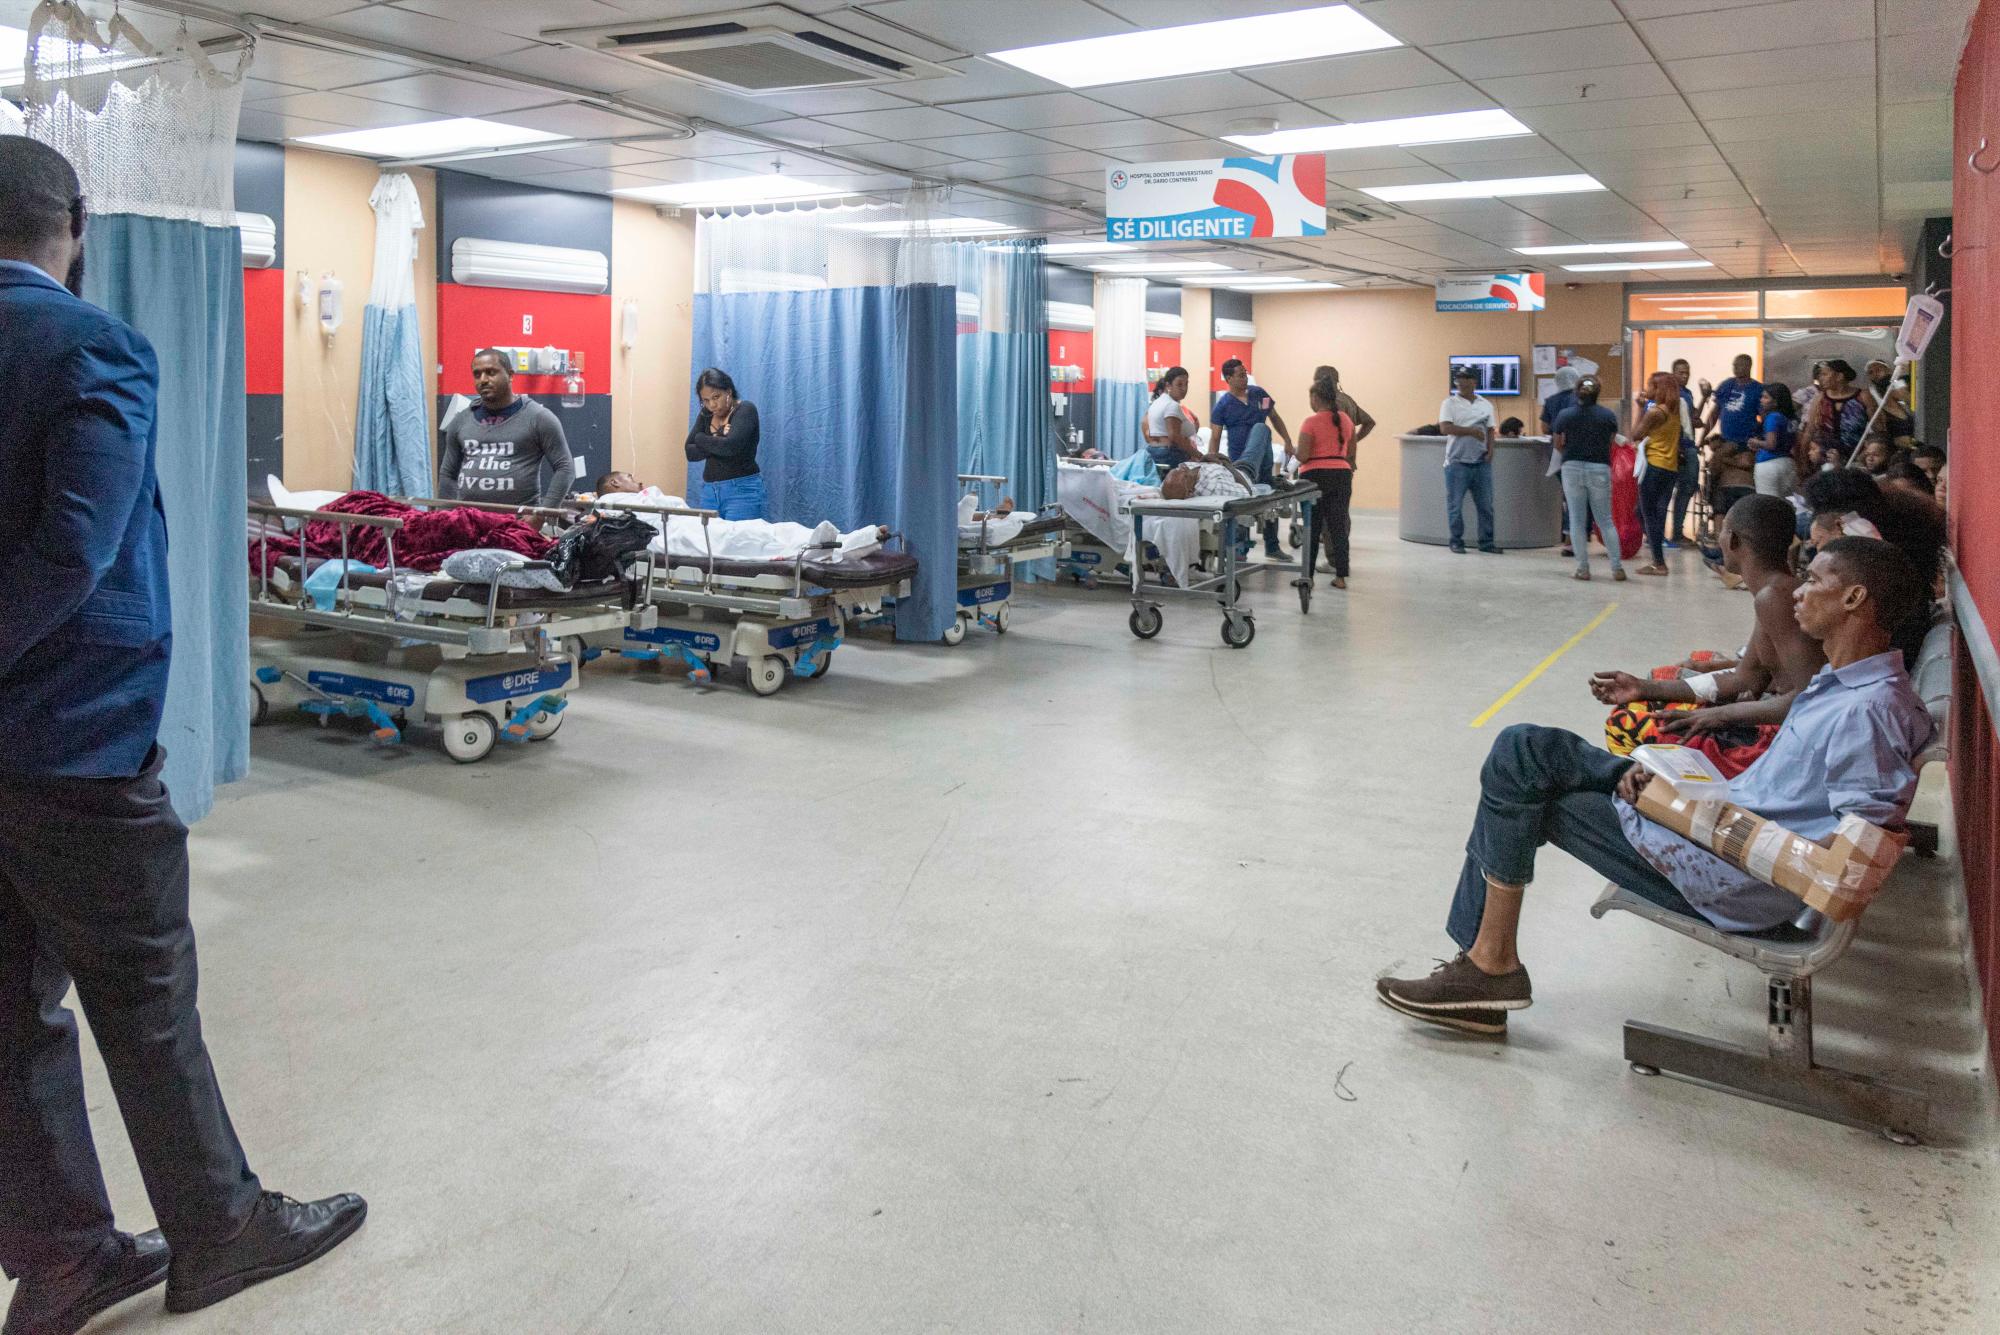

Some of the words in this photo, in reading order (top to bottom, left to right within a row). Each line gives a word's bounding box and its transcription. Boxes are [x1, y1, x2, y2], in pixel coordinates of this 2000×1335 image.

[1176, 169, 1213, 177] UNIVERSITARIO
[1112, 218, 1135, 239] SÉ
[1139, 217, 1246, 239] DILIGENTE
[525, 318, 531, 332] 3
[464, 439, 515, 456] Bun
[478, 456, 512, 470] the
[457, 472, 515, 491] Oven
[800, 623, 818, 637] DRE
[514, 671, 539, 688] DRE
[393, 687, 410, 699] DRE
